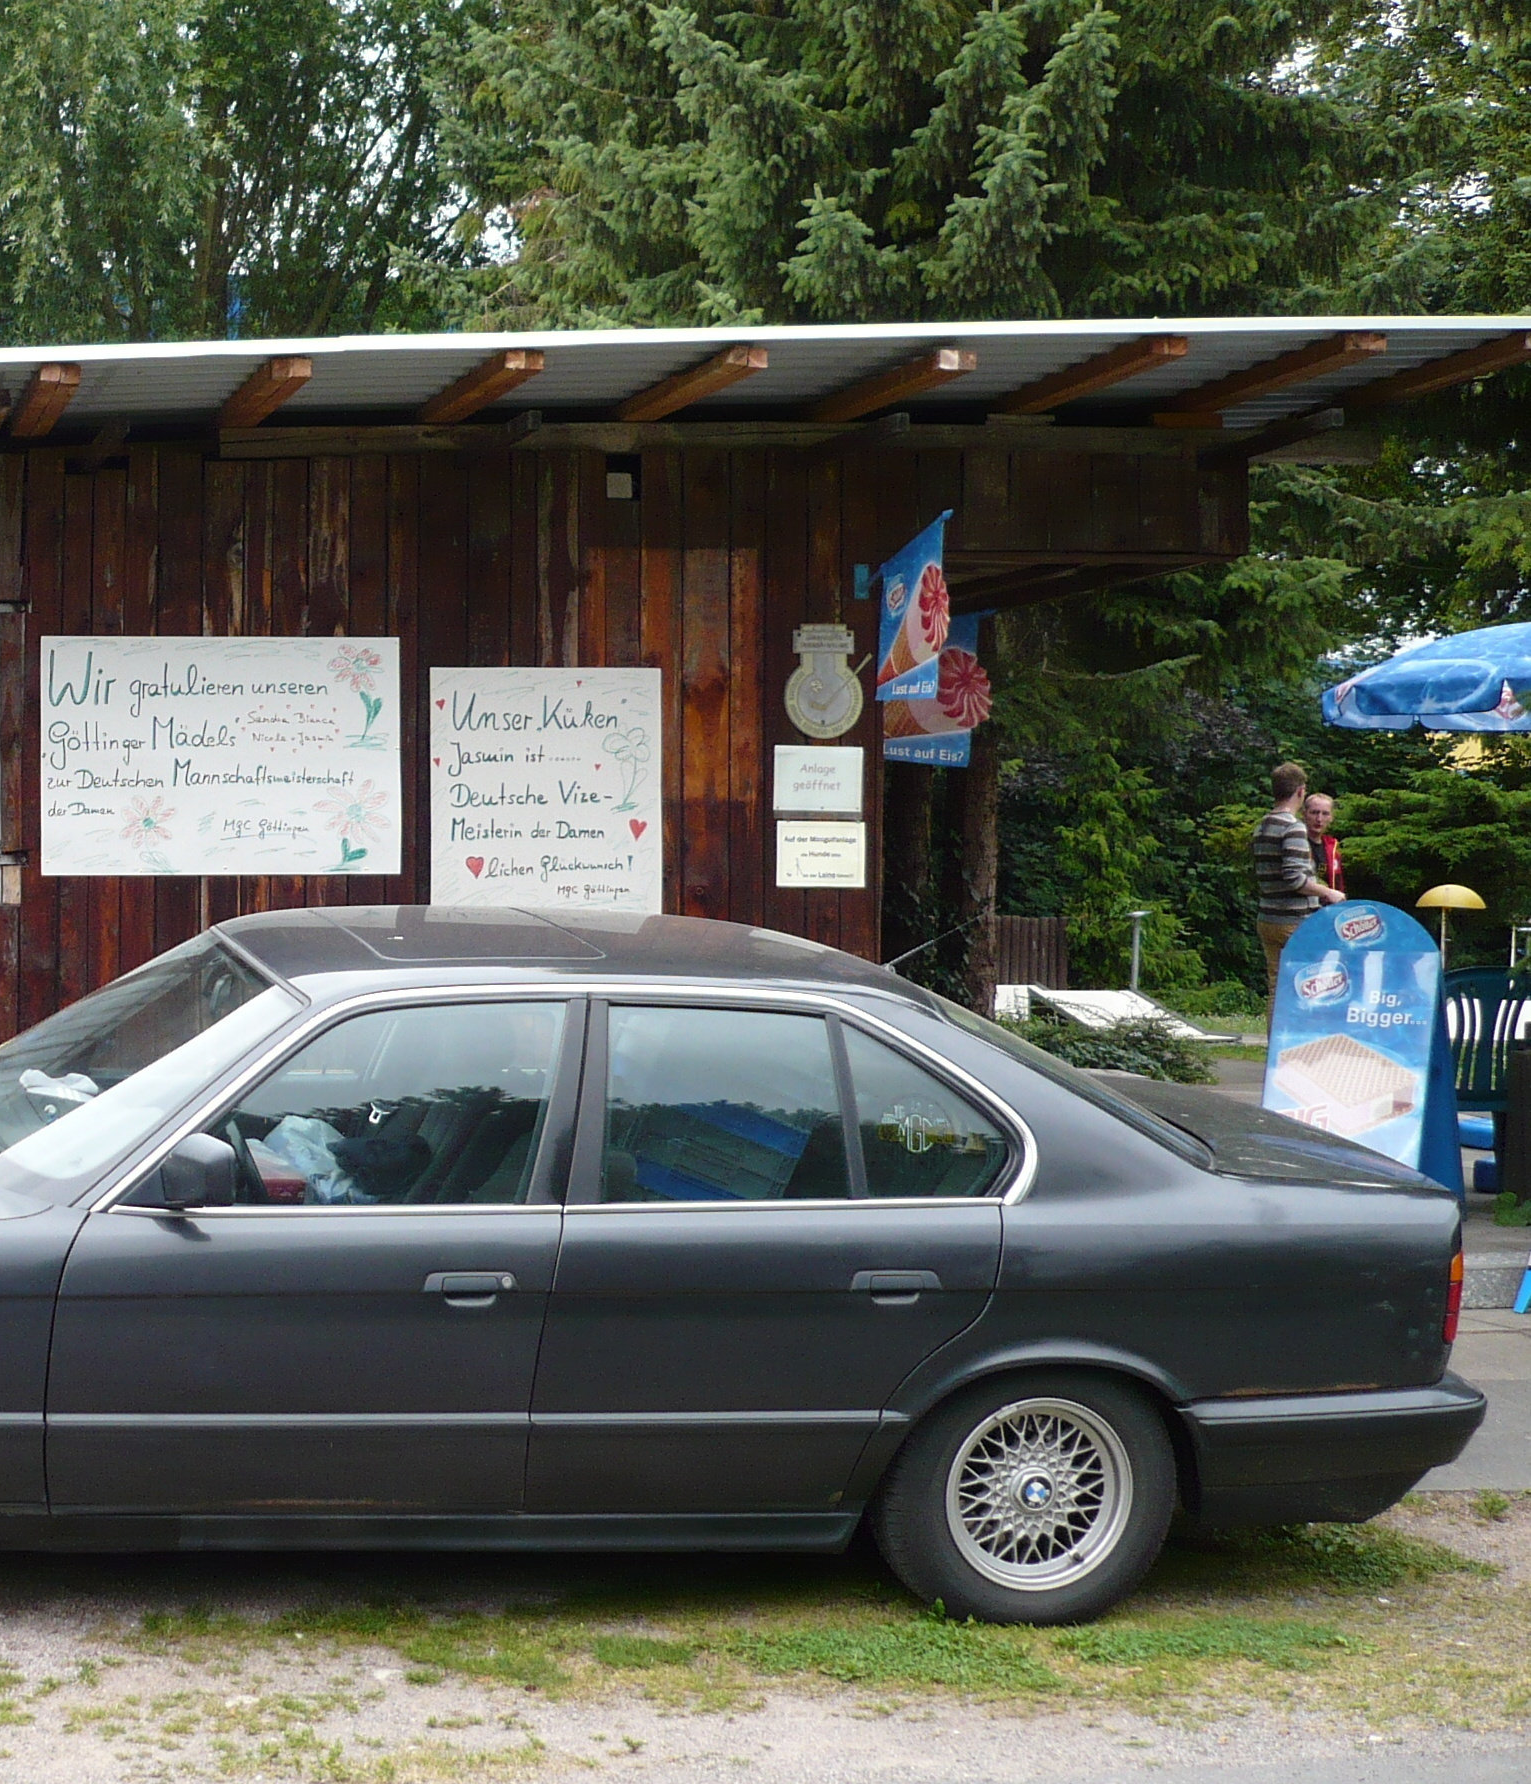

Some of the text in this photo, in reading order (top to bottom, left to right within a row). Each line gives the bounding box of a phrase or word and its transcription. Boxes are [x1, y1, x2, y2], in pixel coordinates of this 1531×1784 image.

[48, 649, 329, 718] Wir gratulieren unseren
[892, 683, 907, 695] Lust
[452, 690, 533, 731] Unser
[448, 742, 514, 777] Jasmin
[883, 743, 964, 762] Lust auf Eis?
[47, 757, 354, 790] zur Deutschen Mannschaftsmeisterschaft
[800, 763, 836, 776] Anlage
[450, 782, 549, 809] Deutsche
[793, 780, 841, 792] geöffnet
[48, 800, 115, 817] der Damen
[450, 817, 605, 842] Meisterin der Damen
[485, 857, 534, 879] lichen
[1369, 990, 1402, 1007] Big,
